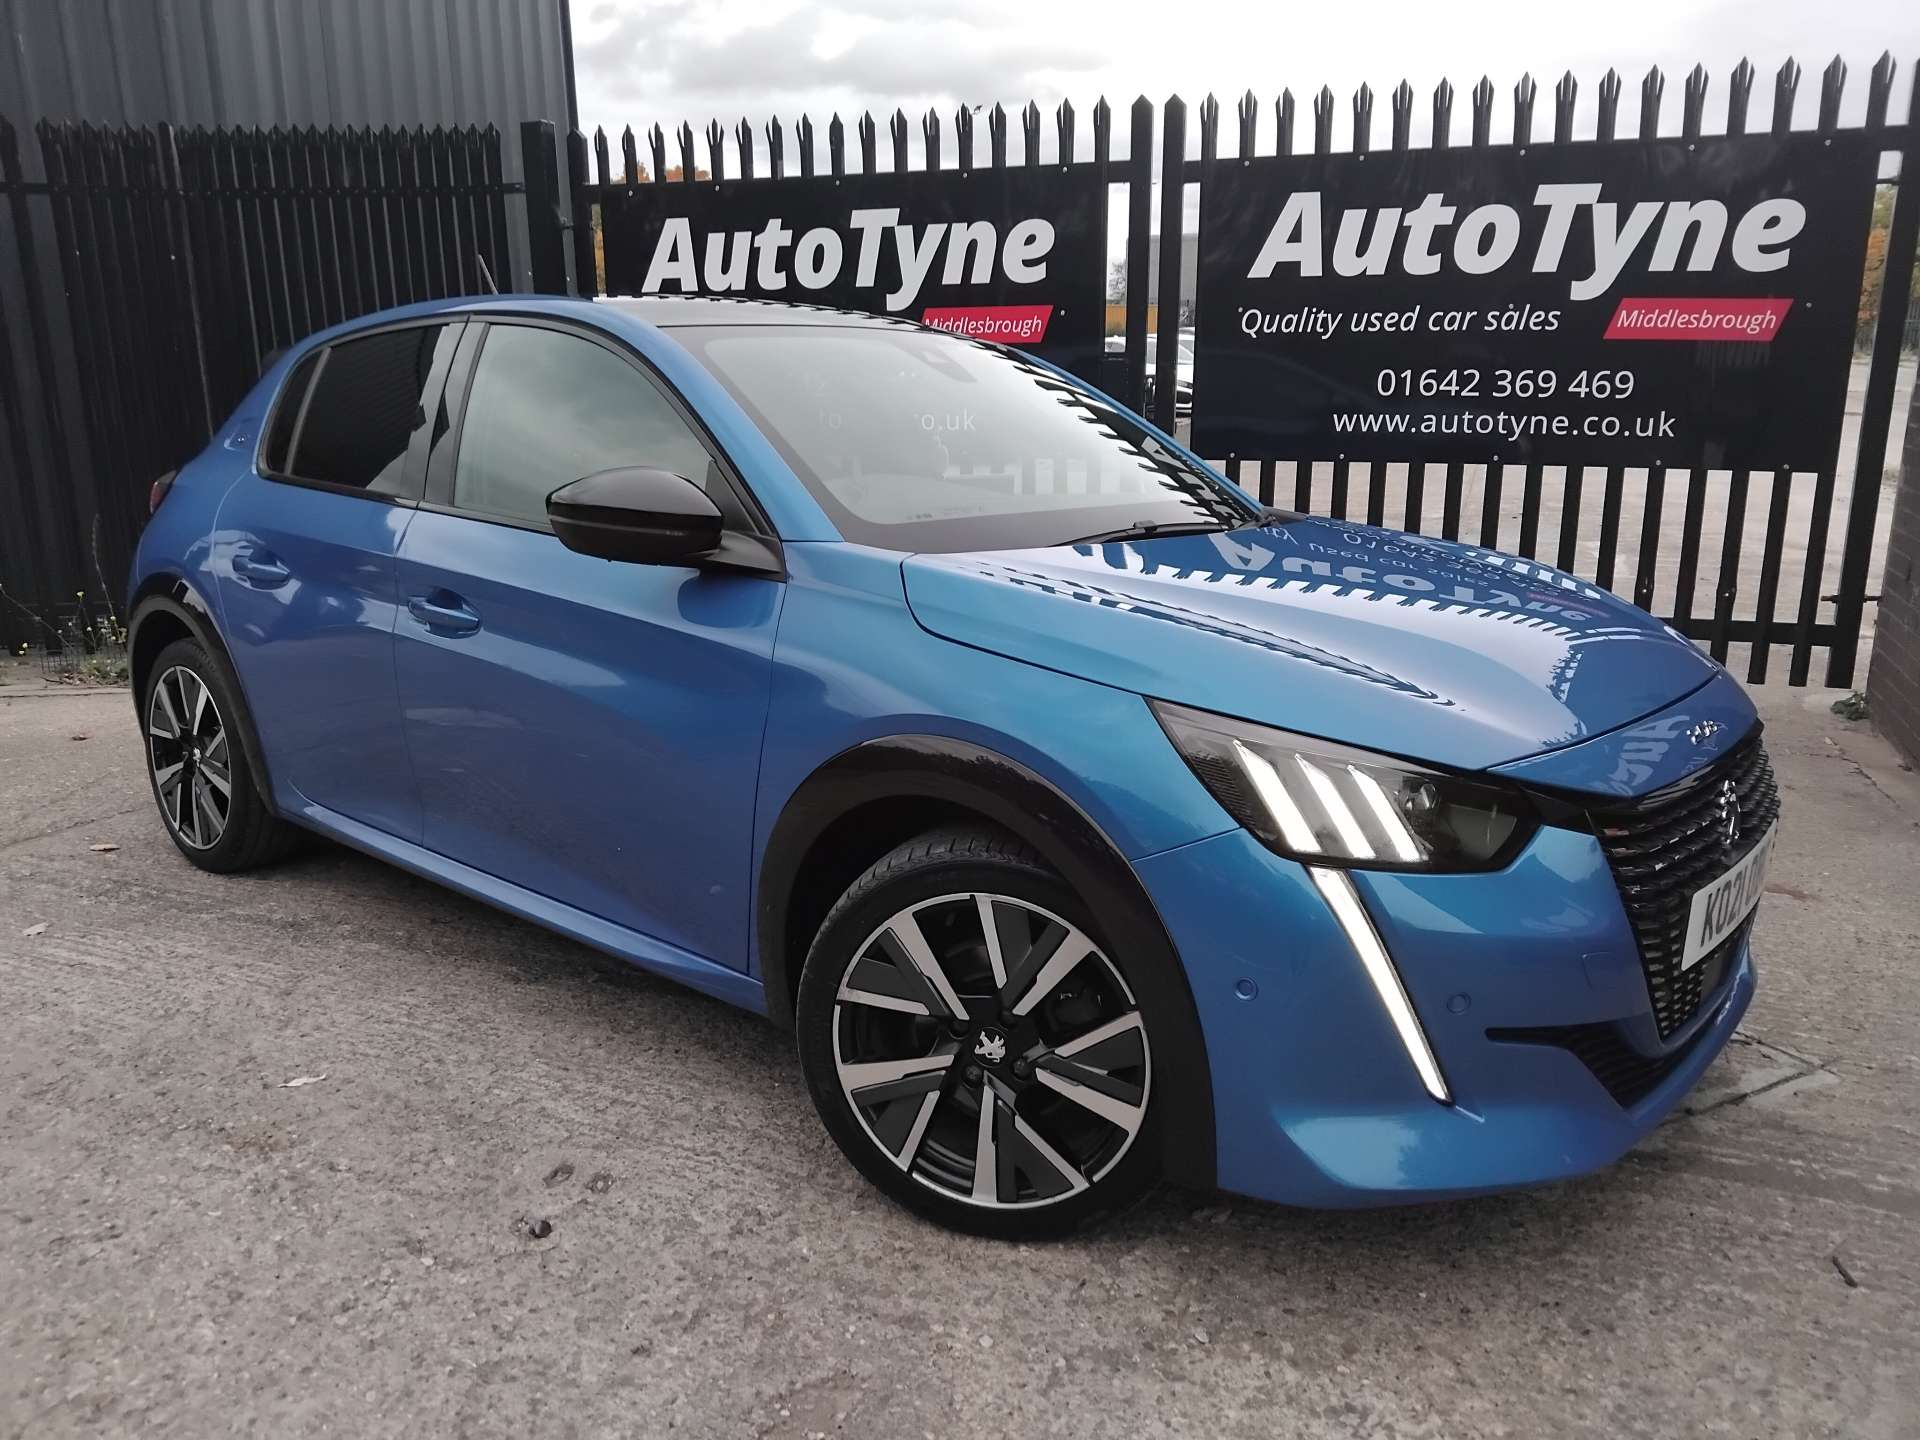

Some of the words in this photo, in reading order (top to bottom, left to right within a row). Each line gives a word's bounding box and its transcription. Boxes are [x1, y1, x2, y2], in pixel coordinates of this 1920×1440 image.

[1247, 182, 1807, 300] AutoTyne
[641, 207, 1055, 311] AutoTyne
[1240, 306, 1342, 340] Quality
[1350, 304, 1420, 332] used
[1428, 309, 1478, 332] car
[1485, 303, 1562, 332] sales
[1616, 309, 1777, 335] Middlesbrough
[1377, 368, 1481, 398] 01642
[1492, 369, 1558, 398] 369
[1568, 370, 1635, 399] 469
[1333, 410, 1676, 441] www.autotyne.co.uk
